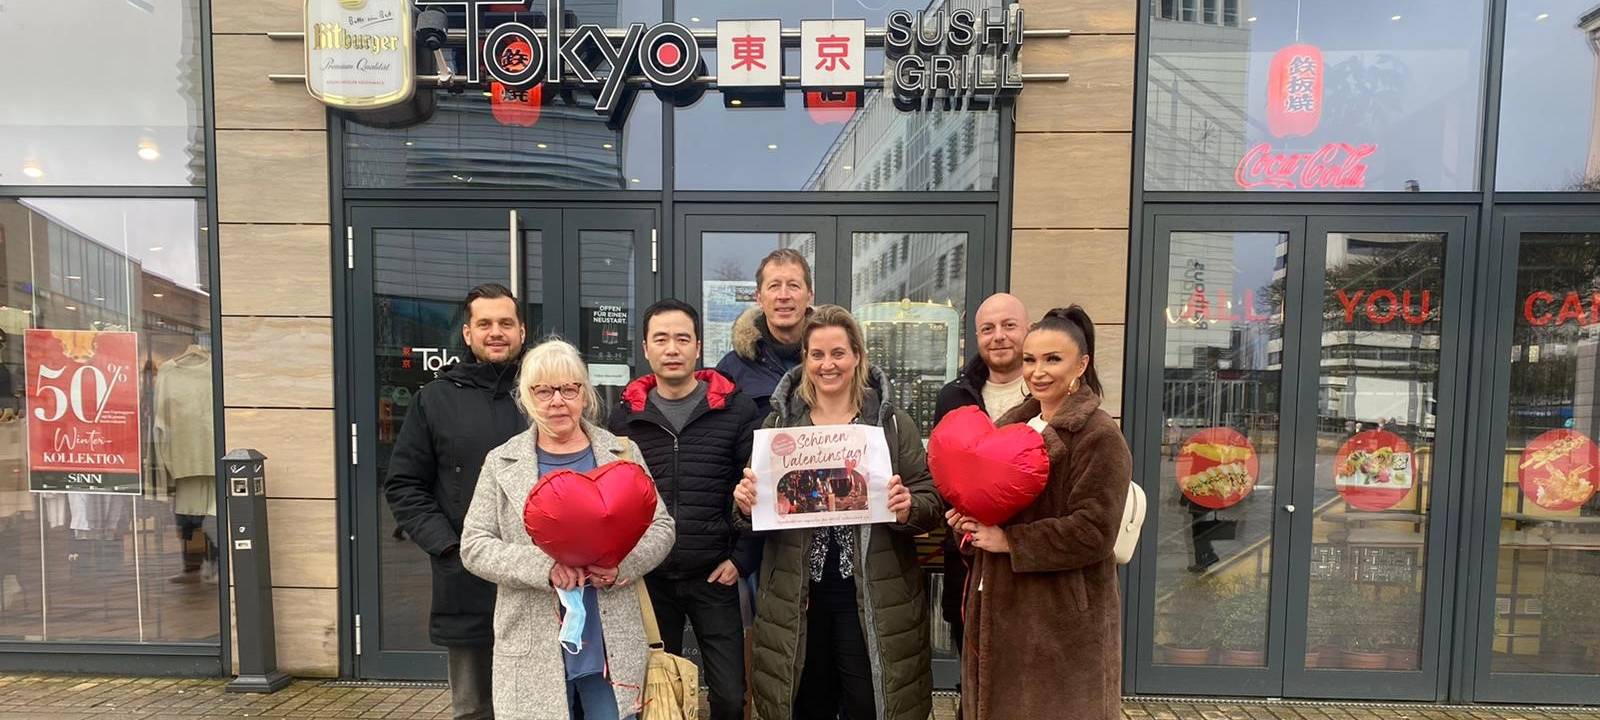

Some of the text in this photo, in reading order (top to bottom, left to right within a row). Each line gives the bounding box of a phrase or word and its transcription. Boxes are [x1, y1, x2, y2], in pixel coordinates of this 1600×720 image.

[312, 22, 400, 55] Bitburger
[887, 9, 1024, 46] SUSHI
[414, 0, 699, 111] Tokyo
[895, 54, 1024, 91] GRILL
[1336, 288, 1430, 327] YOU
[782, 444, 867, 468] Valentinstag!
[797, 431, 848, 449] Schönen
[43, 452, 125, 464] KOLLEKTION
